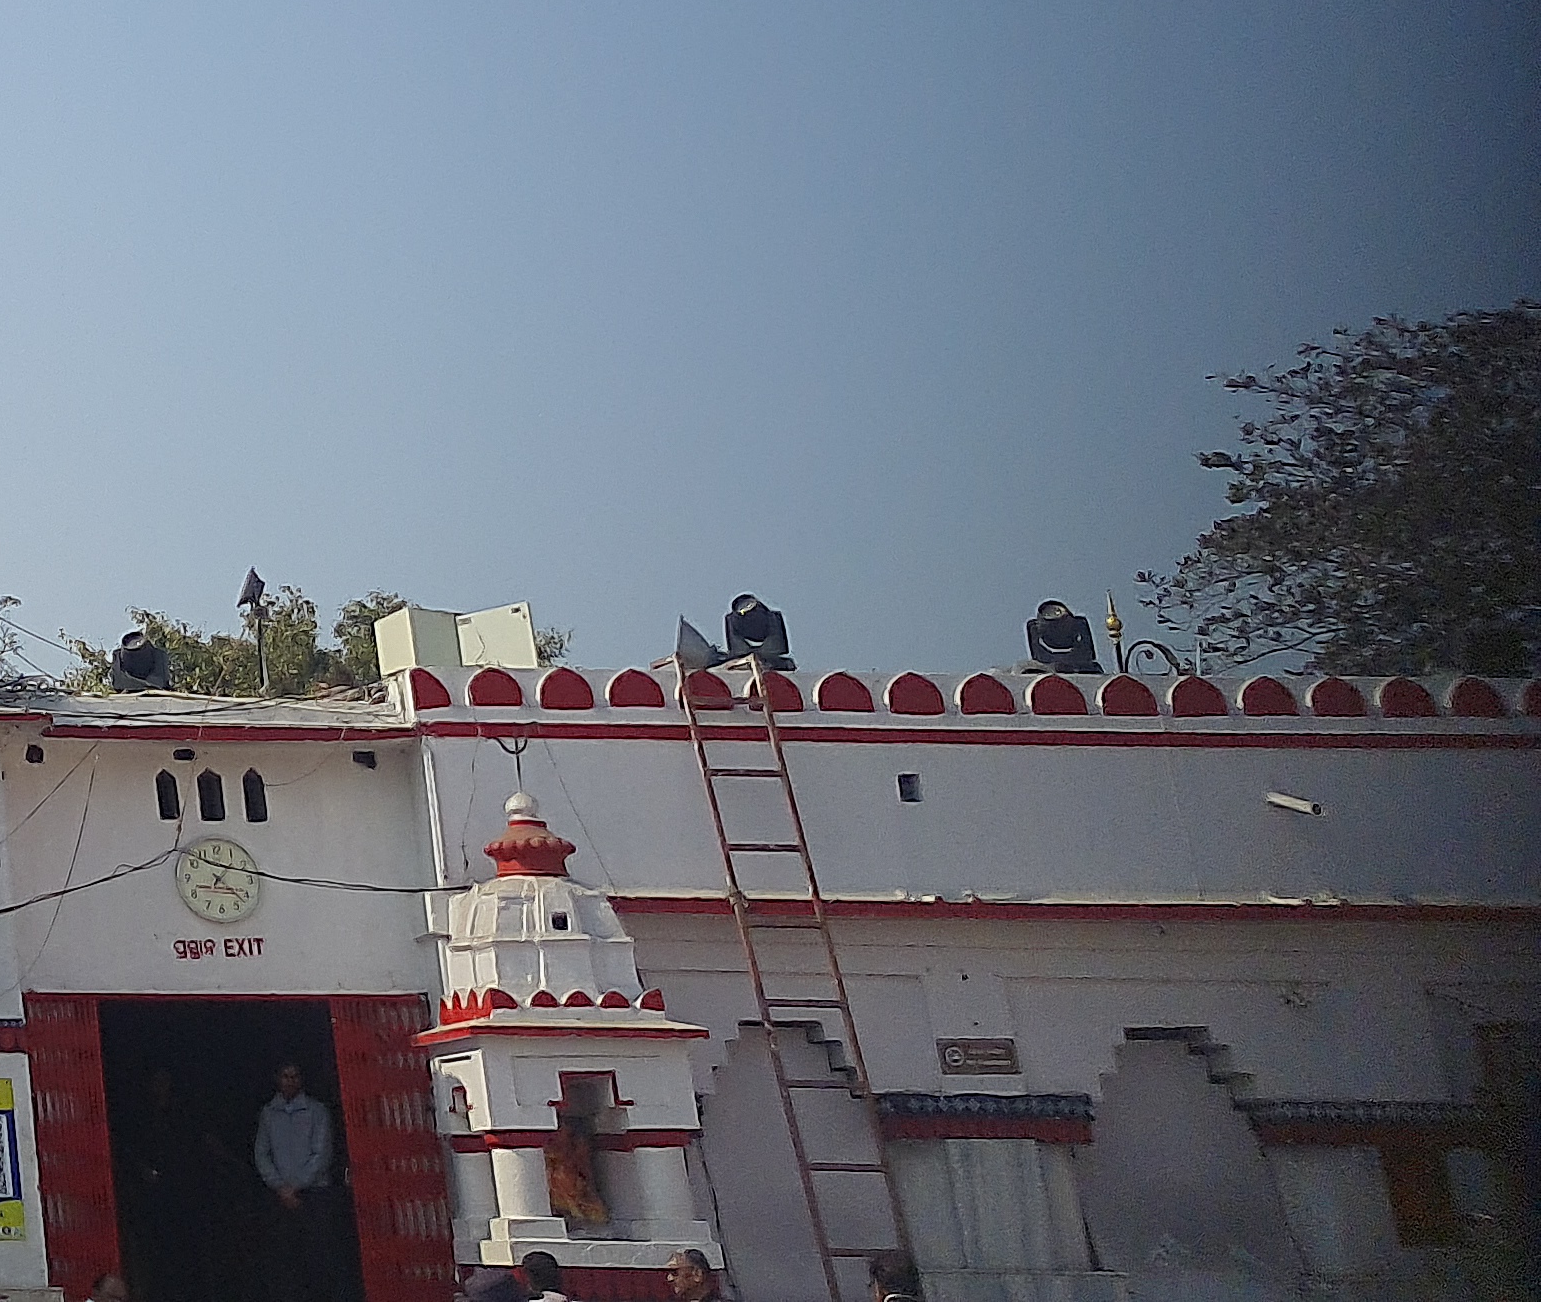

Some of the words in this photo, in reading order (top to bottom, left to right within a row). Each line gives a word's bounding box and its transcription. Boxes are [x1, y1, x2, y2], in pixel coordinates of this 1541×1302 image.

[184, 873, 191, 884] 9
[246, 874, 254, 885] 3
[191, 888, 198, 899] 8
[205, 900, 212, 911] 7
[218, 903, 226, 914] 6
[233, 901, 240, 911] 5
[223, 937, 264, 958] EXIT
